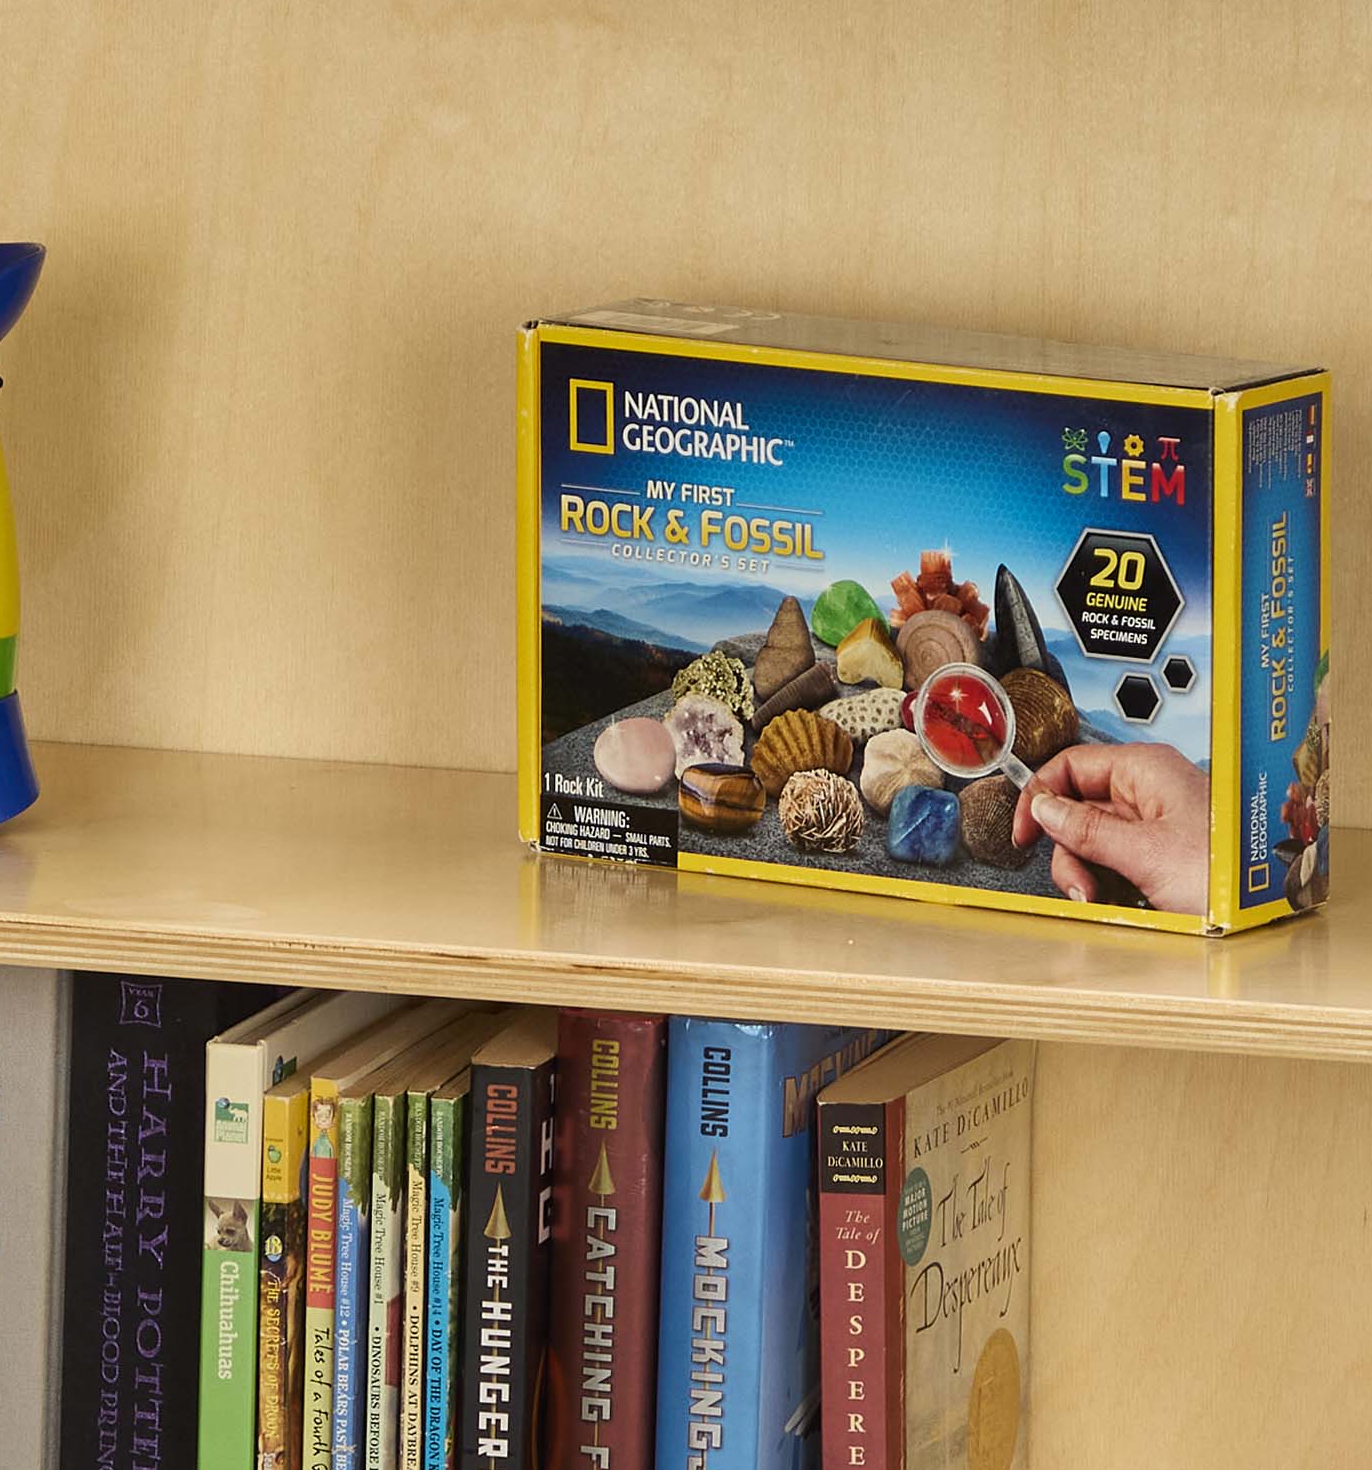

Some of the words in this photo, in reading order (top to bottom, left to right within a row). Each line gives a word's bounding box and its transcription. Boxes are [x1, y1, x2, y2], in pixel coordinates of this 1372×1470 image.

[624, 391, 750, 431] NATIONAL
[646, 480, 676, 501] MY
[681, 483, 735, 506] FIRST
[1062, 453, 1186, 506] STEM
[561, 494, 655, 541] ROCK
[664, 509, 689, 545] &
[700, 510, 824, 559] FOSSIL
[612, 543, 730, 569] COLLECTOR'S
[738, 557, 771, 573] SET
[1090, 548, 1146, 591] 20
[1082, 611, 1110, 625] ROCK
[1111, 614, 1119, 626] &
[1121, 615, 1156, 630] FOSSIL
[1086, 592, 1148, 612] GENUINE
[1090, 628, 1148, 645] SPECIMENS
[544, 772, 550, 792] 1
[555, 773, 584, 795] Rock
[586, 777, 604, 798] Kit
[545, 820, 578, 838] CHOKING
[579, 825, 610, 841] HAZARD
[625, 831, 648, 845] SMALL
[649, 834, 672, 848] PARTS.
[573, 805, 631, 829] WARNING:
[1250, 792, 1260, 861] NATIONAL
[1259, 772, 1268, 860] GEOGRAPHIC
[545, 835, 558, 846] NOT
[560, 836, 573, 848] FOR
[574, 839, 605, 853] CHILDREN
[606, 843, 627, 855] UNDER
[628, 846, 633, 857] 3
[634, 847, 649, 859] YRS.
[590, 1038, 620, 1131] COLLINS
[700, 1046, 732, 1139] COLLINS
[485, 1084, 518, 1175] COLLINS
[842, 1140, 868, 1153] KATE
[136, 1049, 172, 1270] HARRY
[827, 1155, 884, 1169] DiCAMILLO
[311, 1173, 334, 1223] JUDY
[844, 1209, 869, 1224] The
[835, 1226, 860, 1241] Tale
[866, 1227, 881, 1245] of
[308, 1230, 333, 1294] BLUME
[487, 1244, 509, 1289] THE
[217, 1260, 240, 1380] Chihuahuas
[580, 1206, 617, 1422] CATCHING
[910, 1237, 1022, 1373] Despereaux
[313, 1326, 333, 1363] Tales
[431, 1329, 443, 1355] DAY
[310, 1370, 333, 1388] of
[370, 1336, 382, 1410] DINOSAURS
[430, 1356, 442, 1374] OF
[477, 1300, 513, 1458] HUNGER
[313, 1392, 324, 1402] a
[430, 1376, 442, 1404] THE
[311, 1409, 332, 1457] Fourth
[369, 1412, 381, 1464] BEFORE
[428, 1406, 441, 1461] DRAGON
